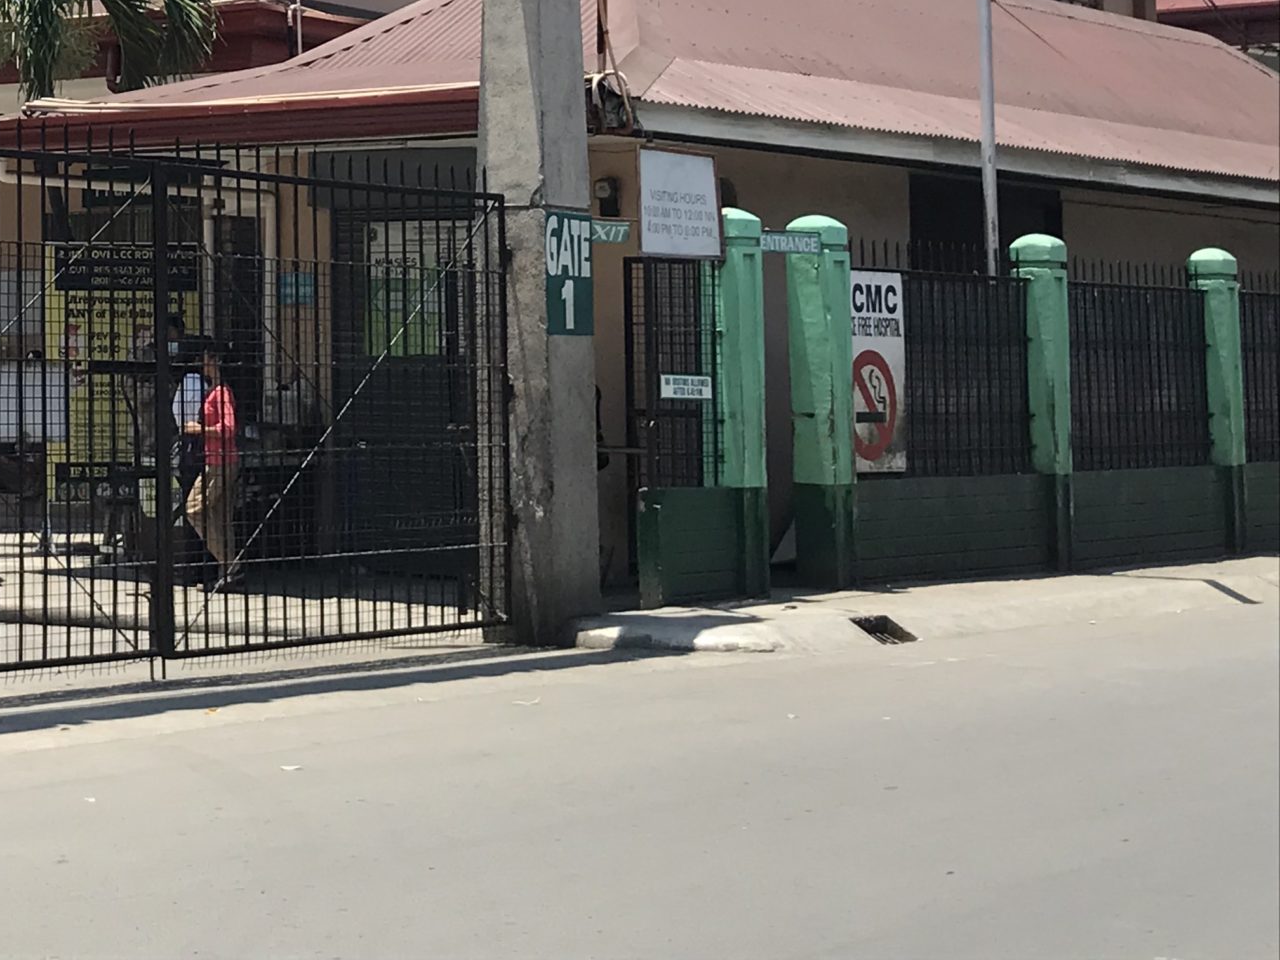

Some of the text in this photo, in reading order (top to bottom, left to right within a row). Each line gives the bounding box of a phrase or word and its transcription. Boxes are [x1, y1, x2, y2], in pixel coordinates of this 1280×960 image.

[592, 223, 630, 243] XIT
[545, 215, 591, 277] GATE
[760, 235, 819, 253] ENTRANCE
[375, 257, 417, 267] MEASES
[561, 279, 575, 330] 1
[852, 283, 898, 314] CMC
[858, 317, 873, 337] FREE
[874, 317, 902, 338] HOSPITAL
